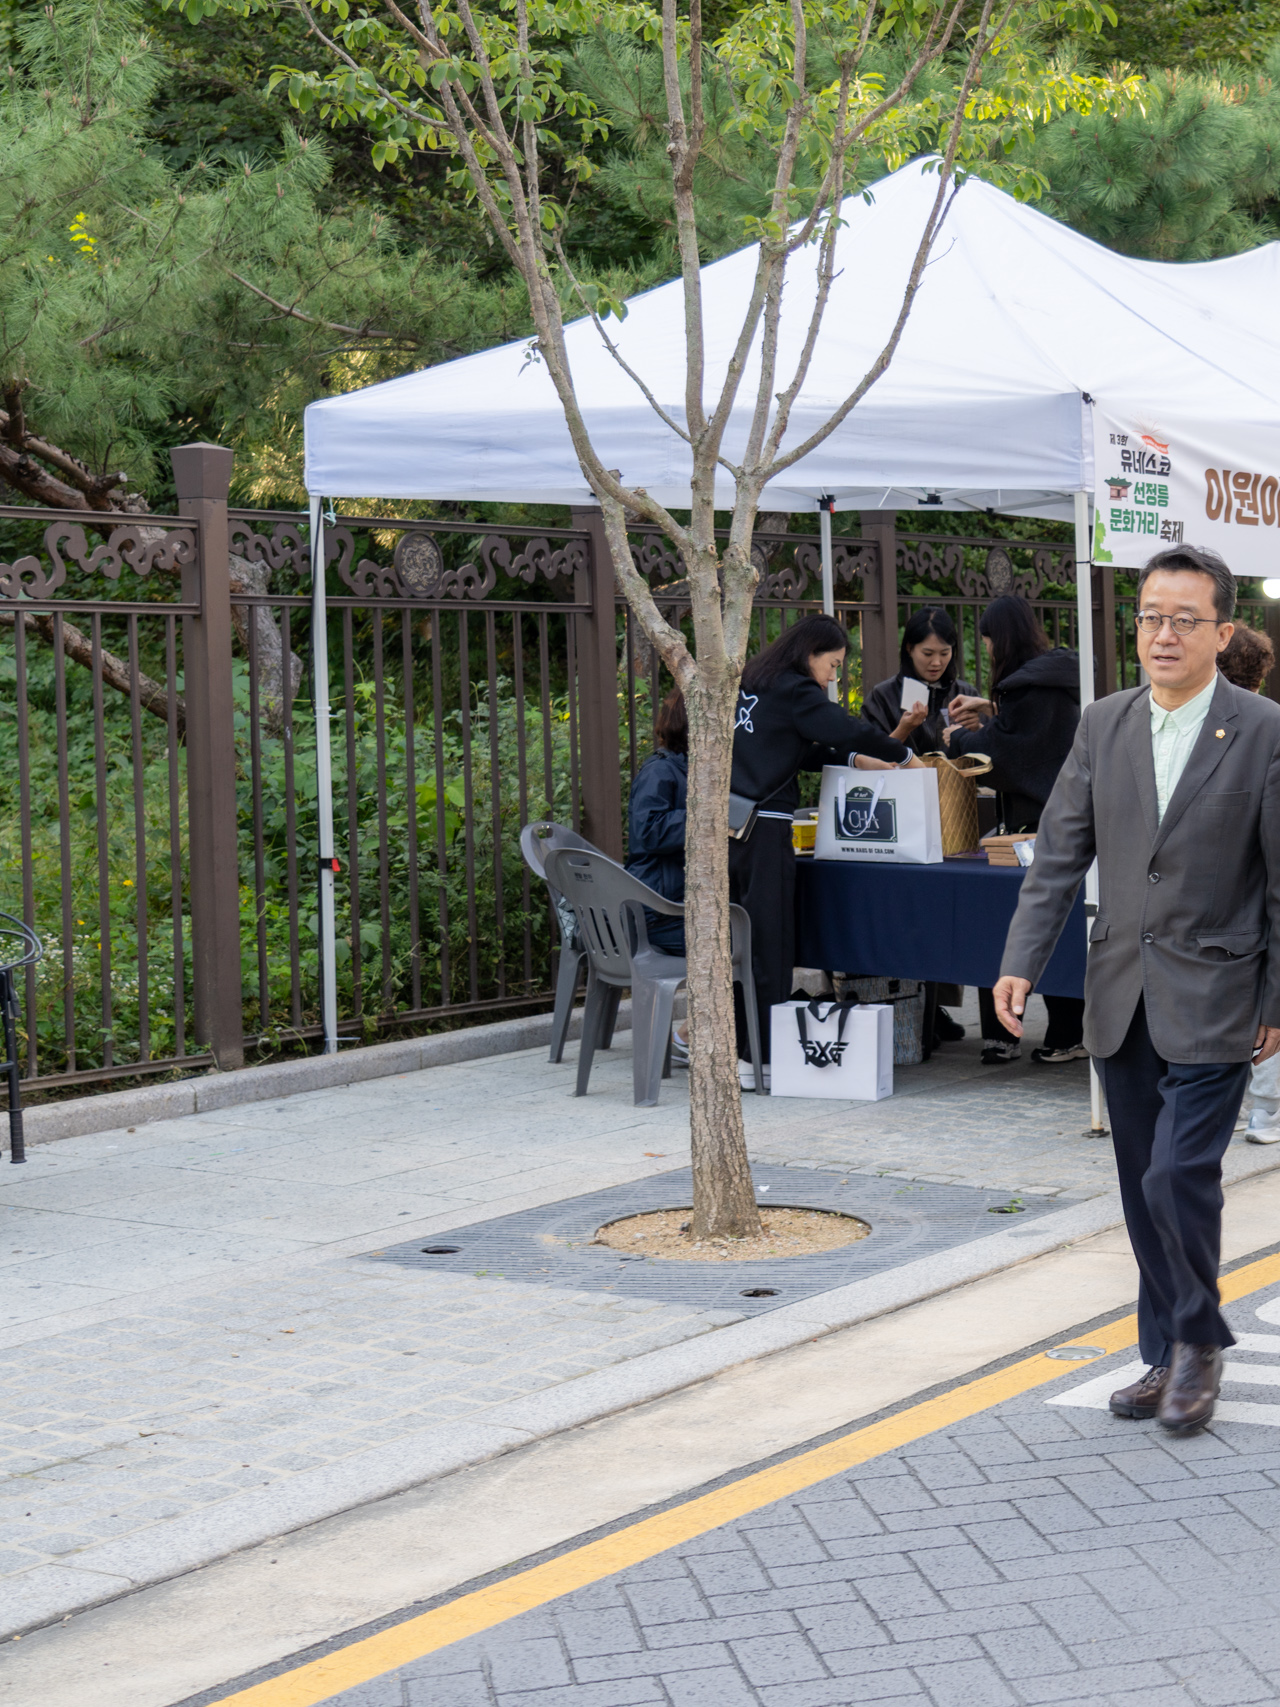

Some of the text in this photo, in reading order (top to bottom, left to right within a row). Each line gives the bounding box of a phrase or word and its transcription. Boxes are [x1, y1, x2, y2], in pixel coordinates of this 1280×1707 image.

[1121, 449, 1171, 477] 유네스코
[1134, 482, 1169, 507] 선정릉
[1110, 508, 1184, 543] 문화거리 축제
[848, 809, 880, 829] CHA
